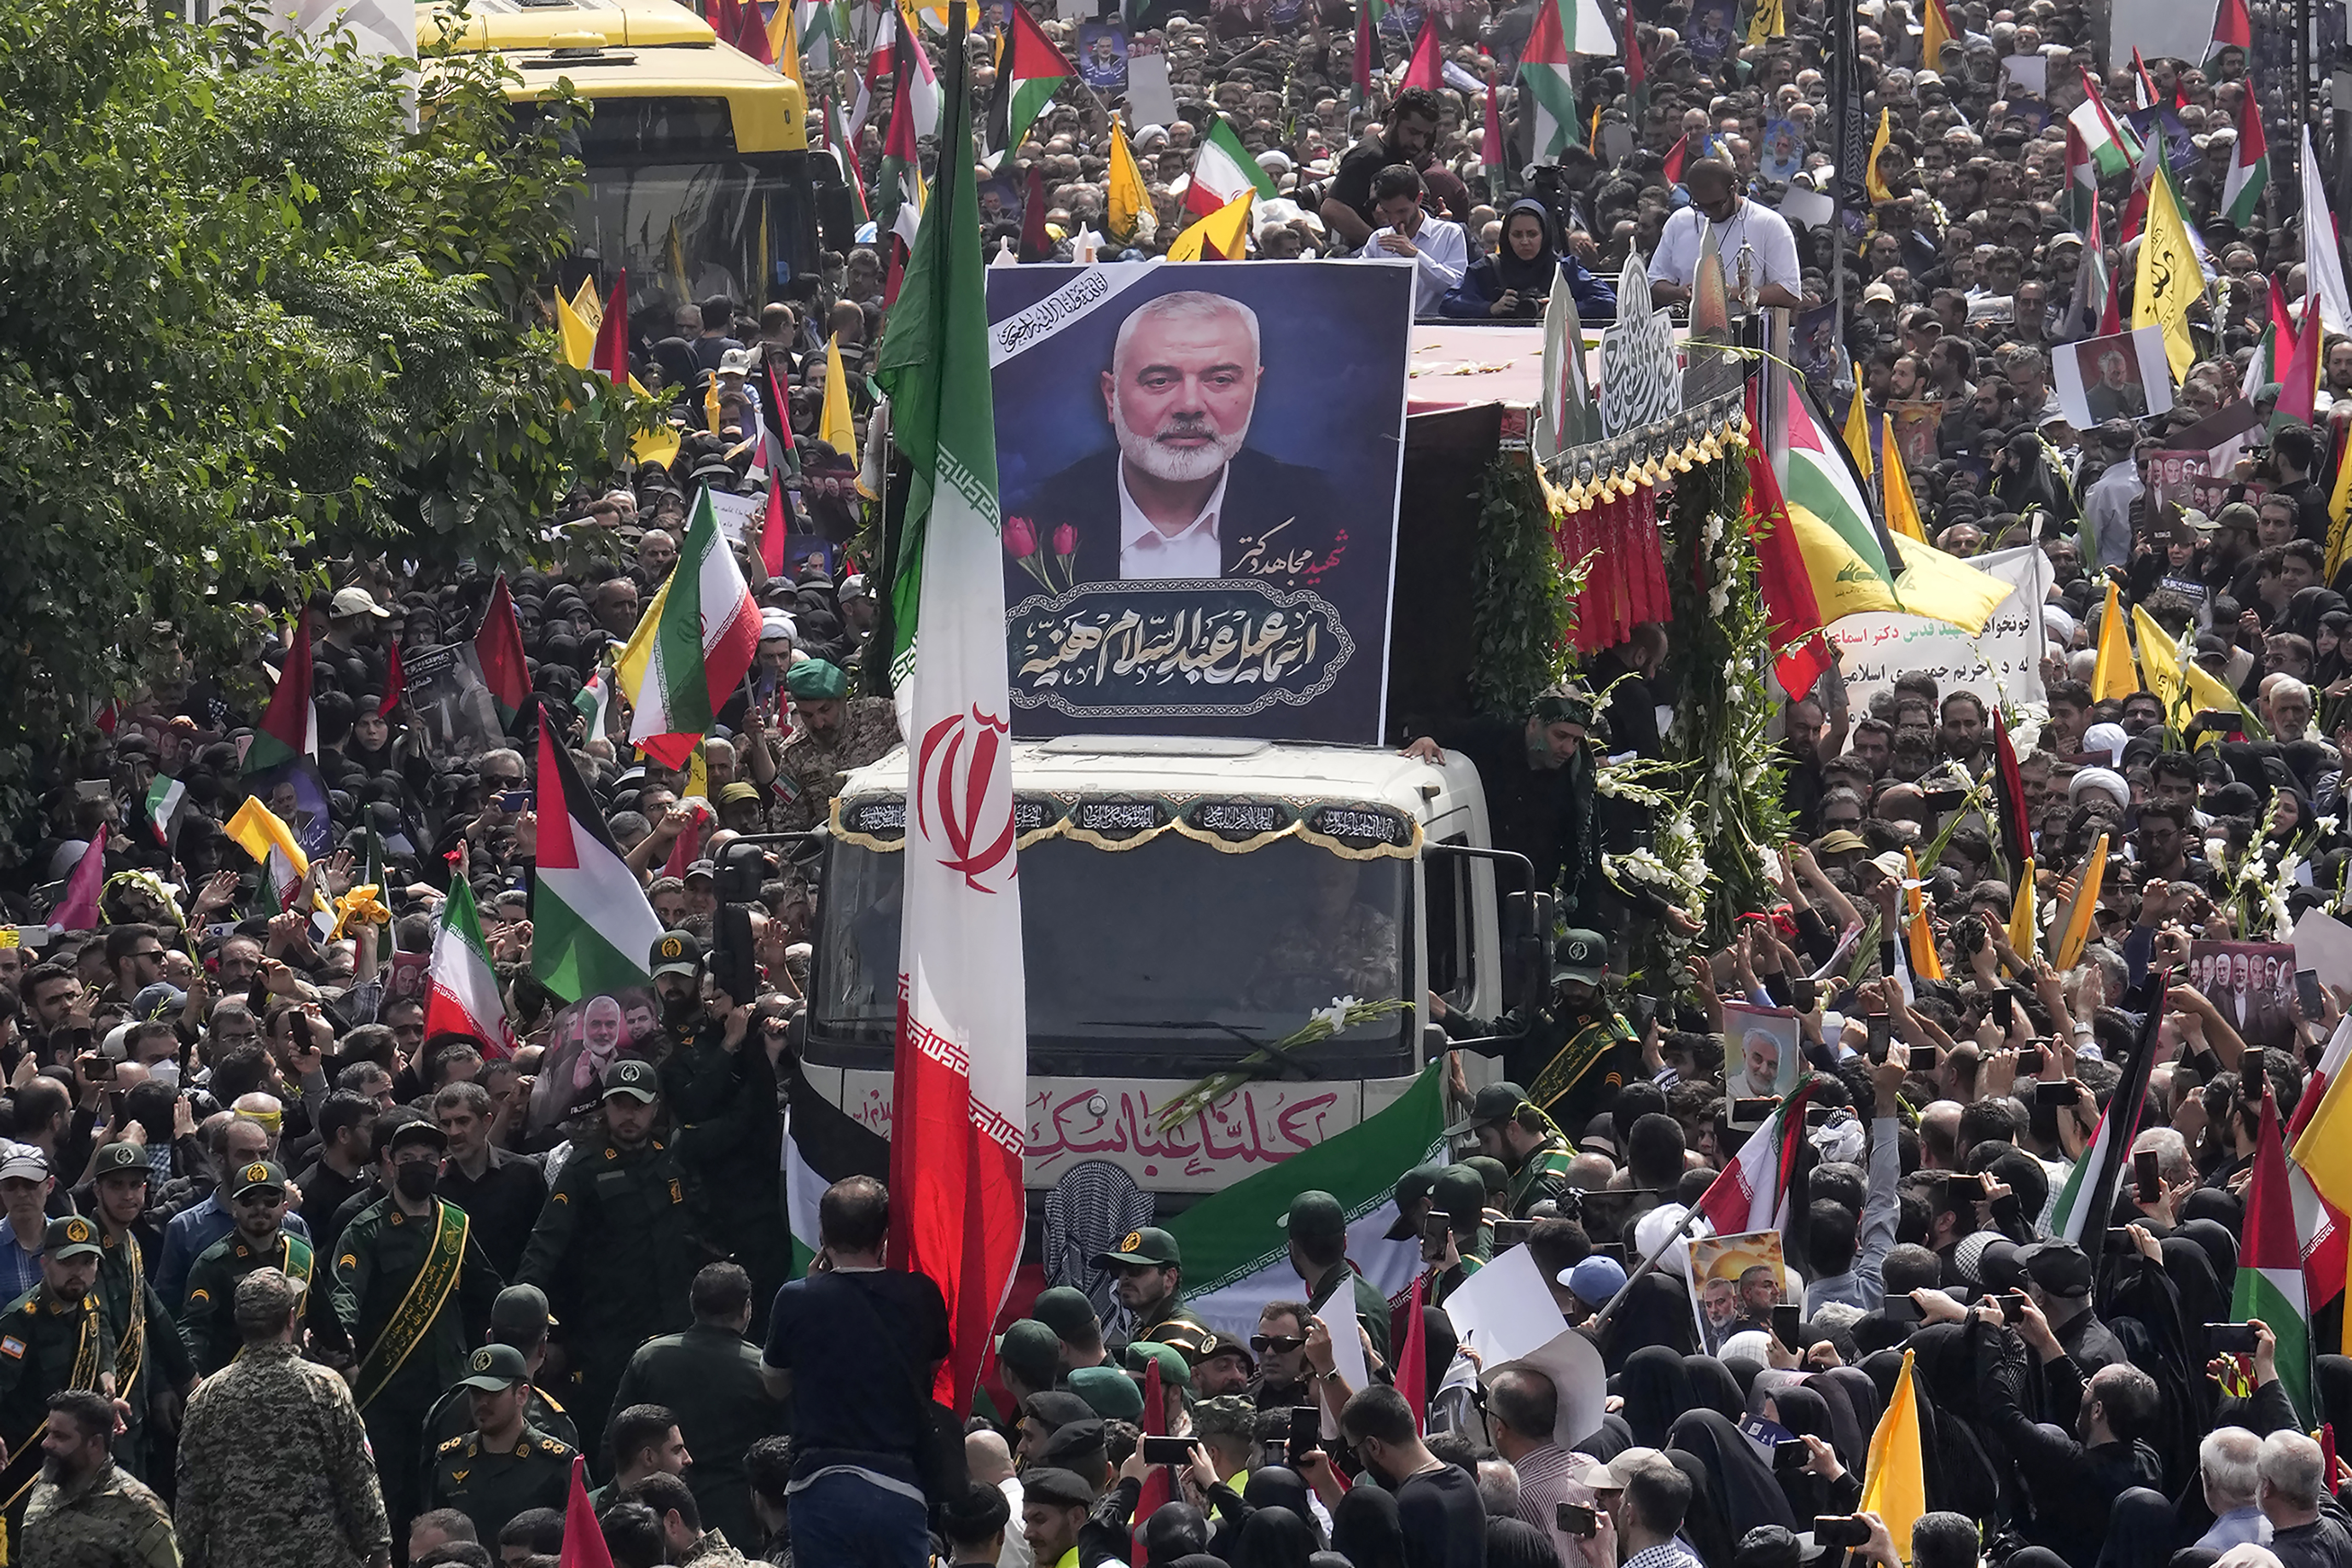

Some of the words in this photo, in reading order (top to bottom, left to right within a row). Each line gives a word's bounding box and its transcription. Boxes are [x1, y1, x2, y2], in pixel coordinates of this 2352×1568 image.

[1228, 516, 1296, 573] دکتر
[1254, 548, 1313, 586] مجاهد
[1301, 528, 1348, 585] شهید
[1825, 628, 1867, 643] اسماعل
[1872, 625, 1899, 646] دکتر
[1903, 619, 1934, 642] قدس
[1939, 621, 1968, 639] هید
[1203, 610, 1317, 683] اسماعیل
[1842, 663, 1885, 687] اسلامی
[1953, 664, 1987, 683] حریم
